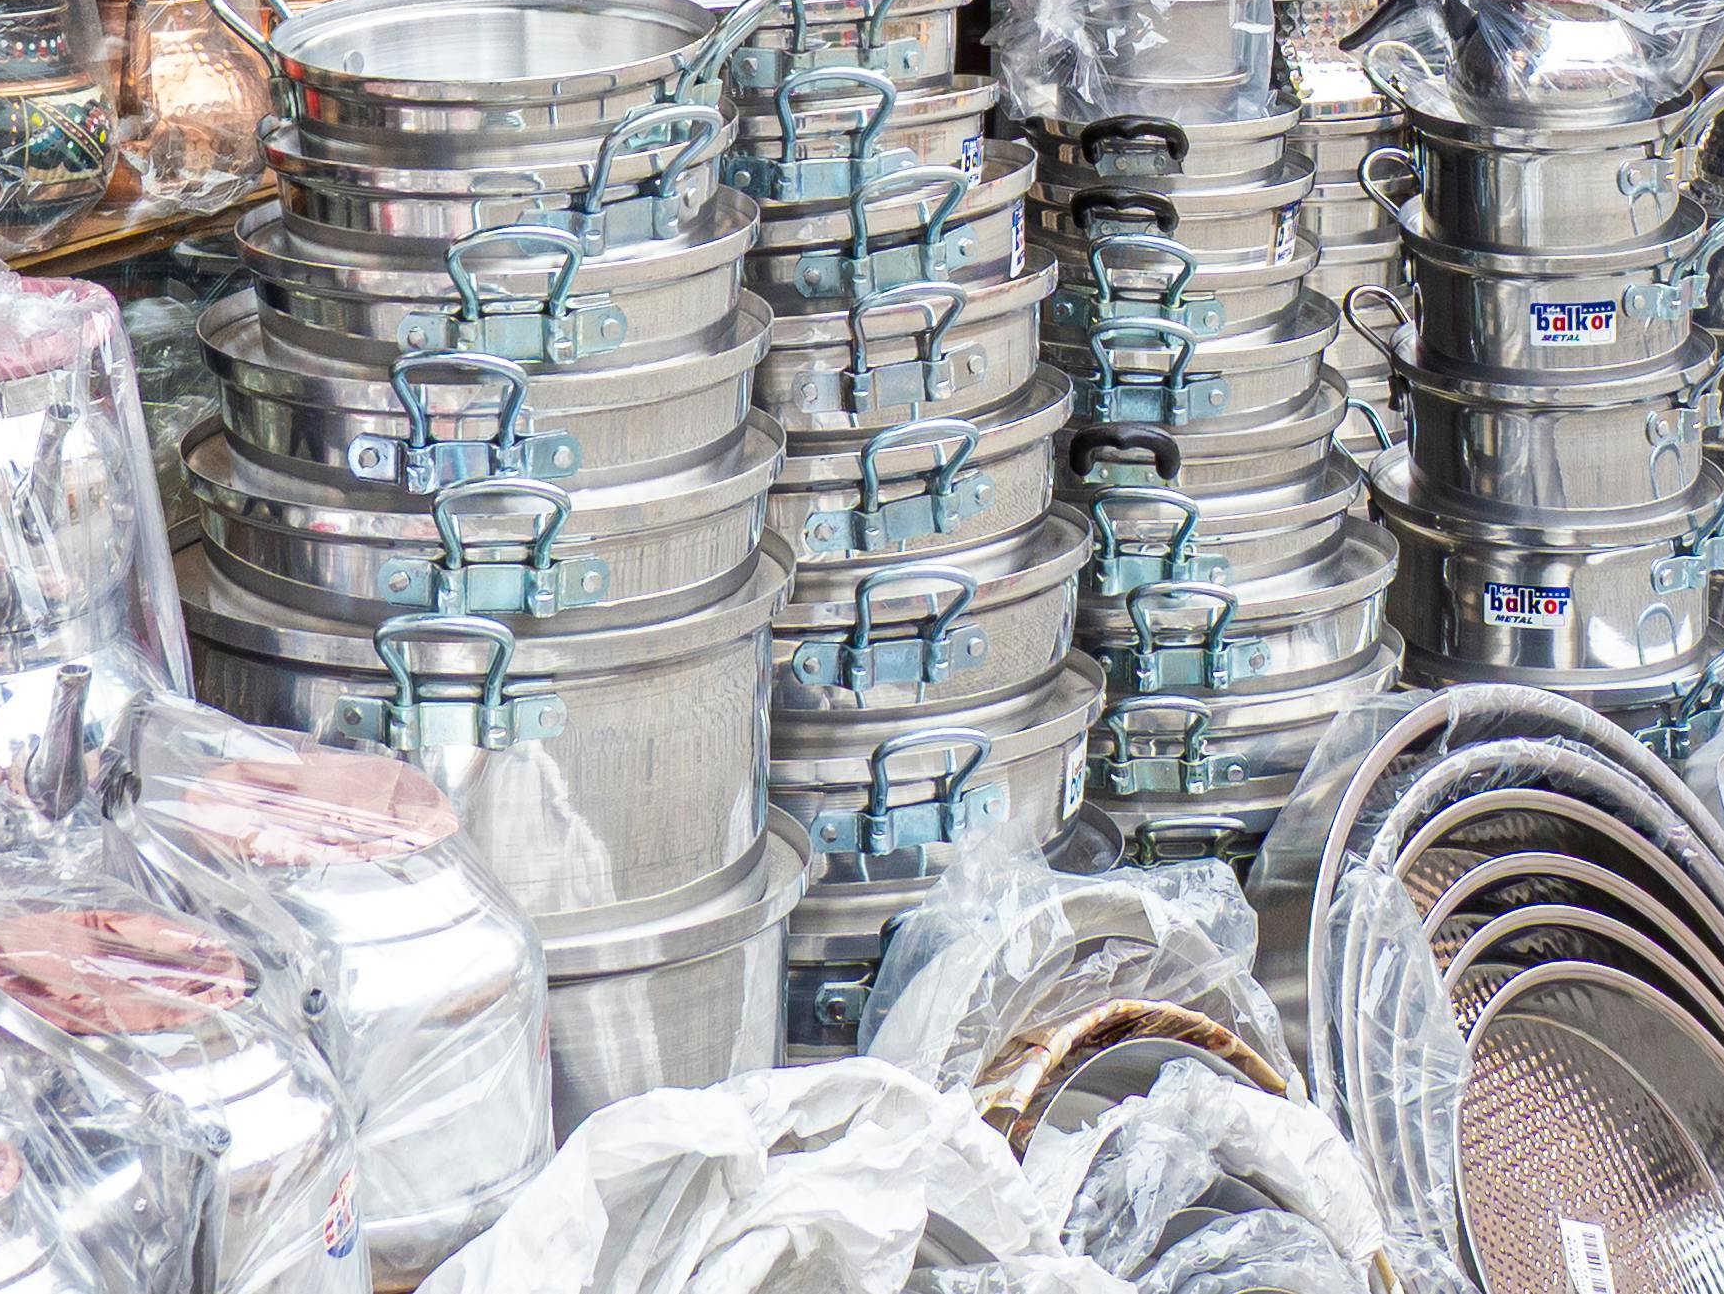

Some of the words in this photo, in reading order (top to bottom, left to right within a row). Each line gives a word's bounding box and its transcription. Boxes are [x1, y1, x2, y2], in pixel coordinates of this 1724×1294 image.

[1536, 307, 1613, 331] balkor
[1541, 334, 1580, 342] METAL
[1490, 586, 1568, 614] balkor
[1495, 614, 1533, 625] METAL
